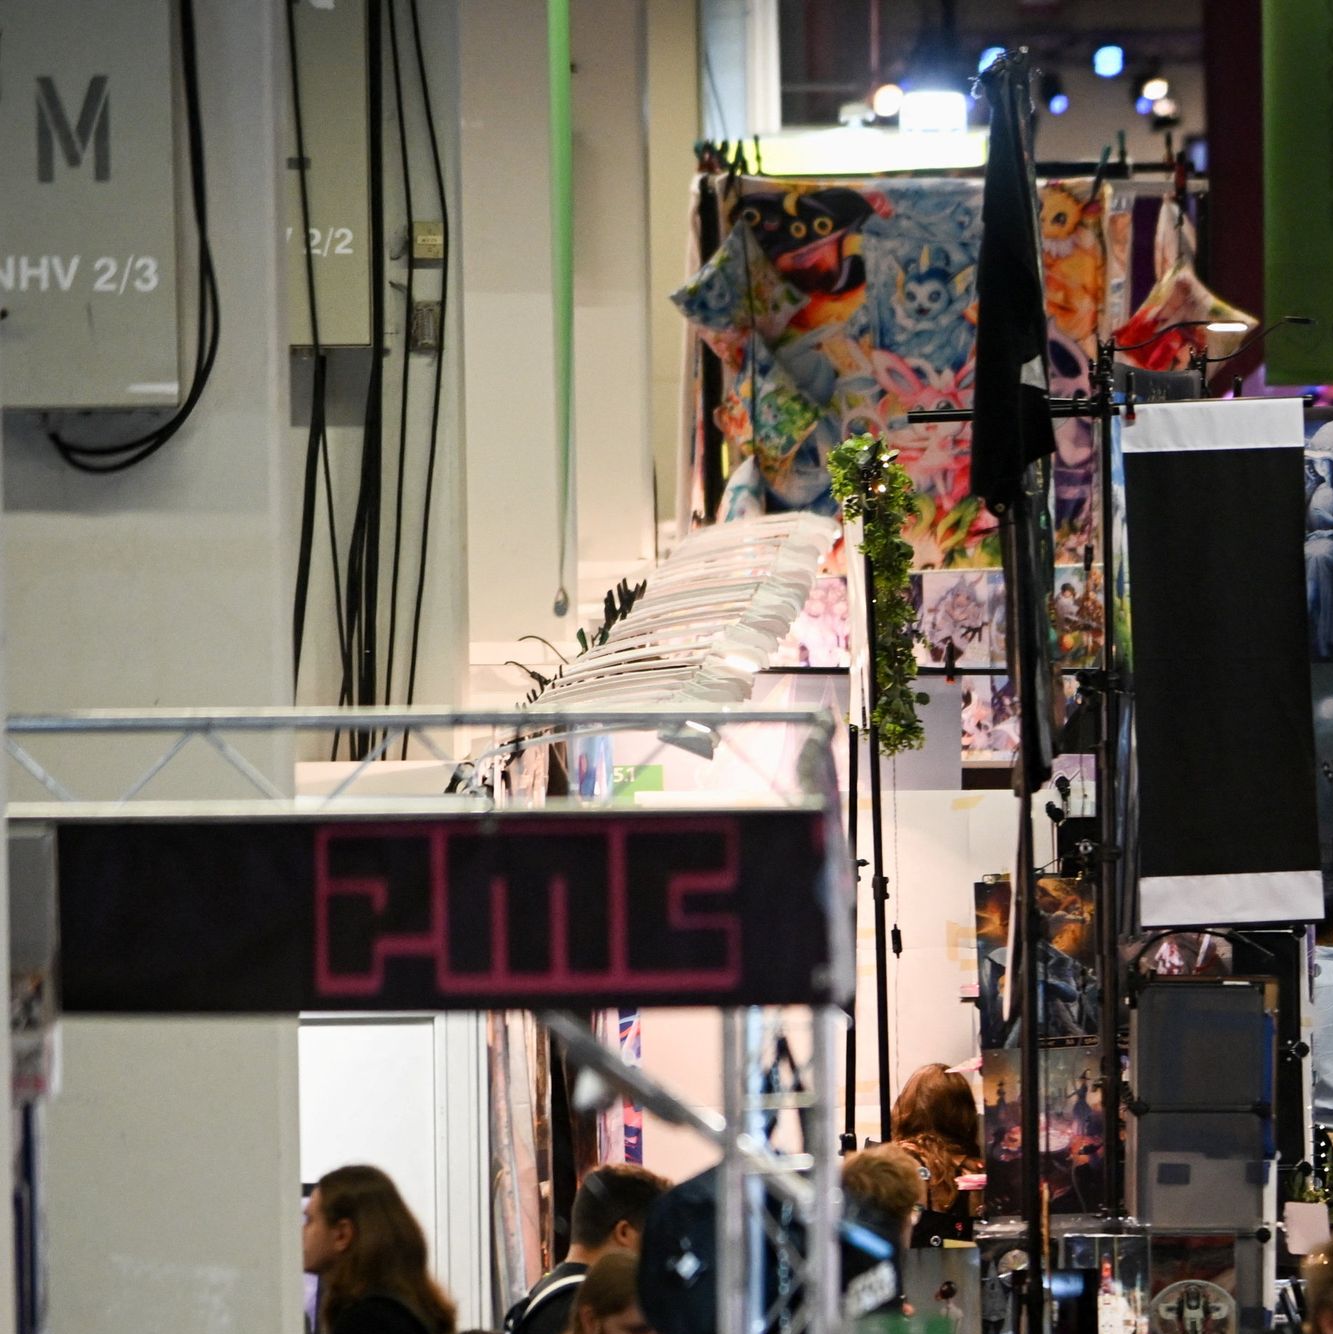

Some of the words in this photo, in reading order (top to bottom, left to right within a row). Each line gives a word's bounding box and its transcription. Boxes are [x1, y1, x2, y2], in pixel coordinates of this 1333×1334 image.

[36, 75, 111, 183] M
[93, 255, 159, 295] 2/3
[612, 766, 636, 783] 5.1
